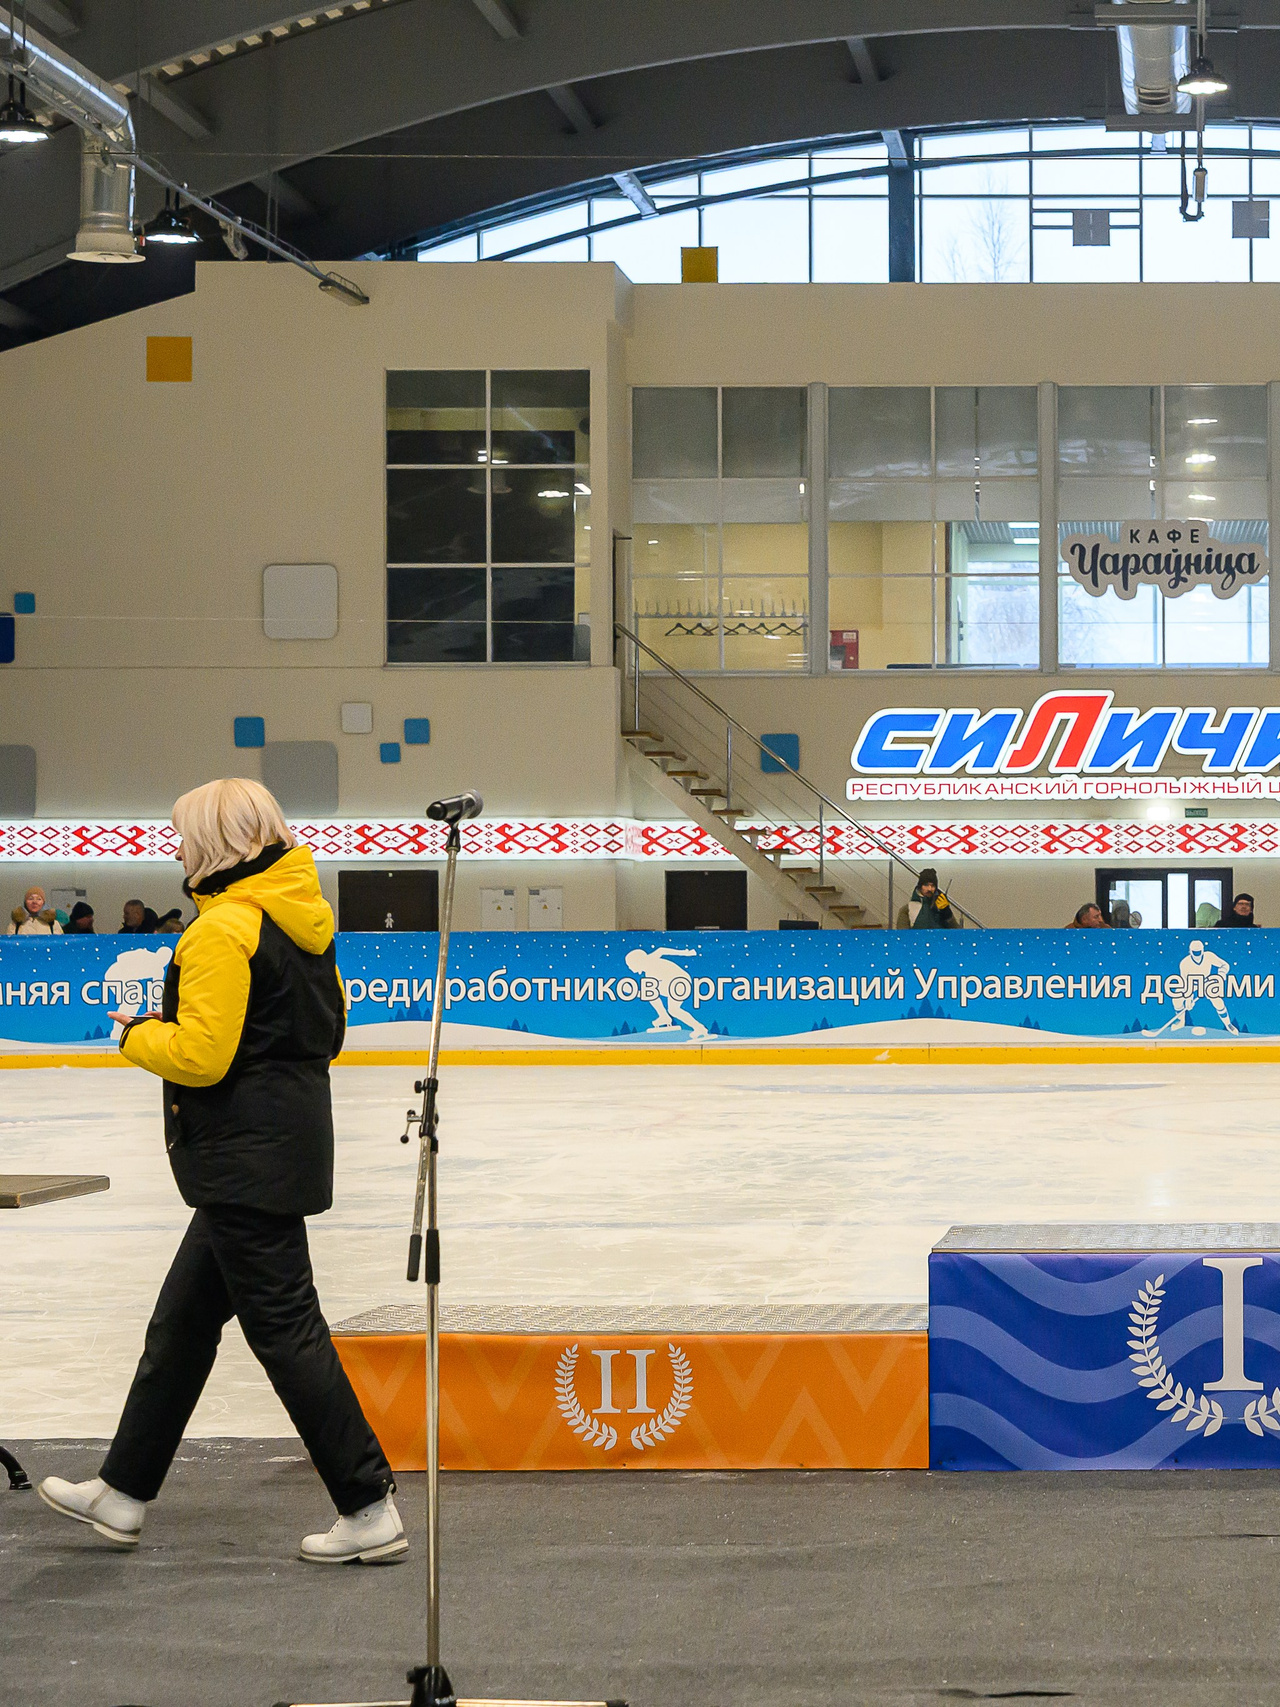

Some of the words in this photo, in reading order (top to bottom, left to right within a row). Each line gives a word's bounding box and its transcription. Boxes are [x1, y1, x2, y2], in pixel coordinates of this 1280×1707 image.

[1129, 528, 1200, 544] КАФЕ
[1069, 542, 1261, 592] Чараўніца
[851, 778, 1078, 796] РЕСПУБЛИКАНСКИЙ
[1083, 777, 1262, 795] ГОРНОЛЫЖНЫЙ
[0, 979, 71, 1007] няя
[80, 979, 164, 1012] спар
[344, 977, 434, 1011] реди
[444, 968, 660, 1010] работников
[667, 967, 906, 1007] организаций
[913, 967, 1132, 1007] Управления
[1139, 972, 1276, 1005] делами
[1202, 1257, 1264, 1391] I
[591, 1349, 657, 1414] II
